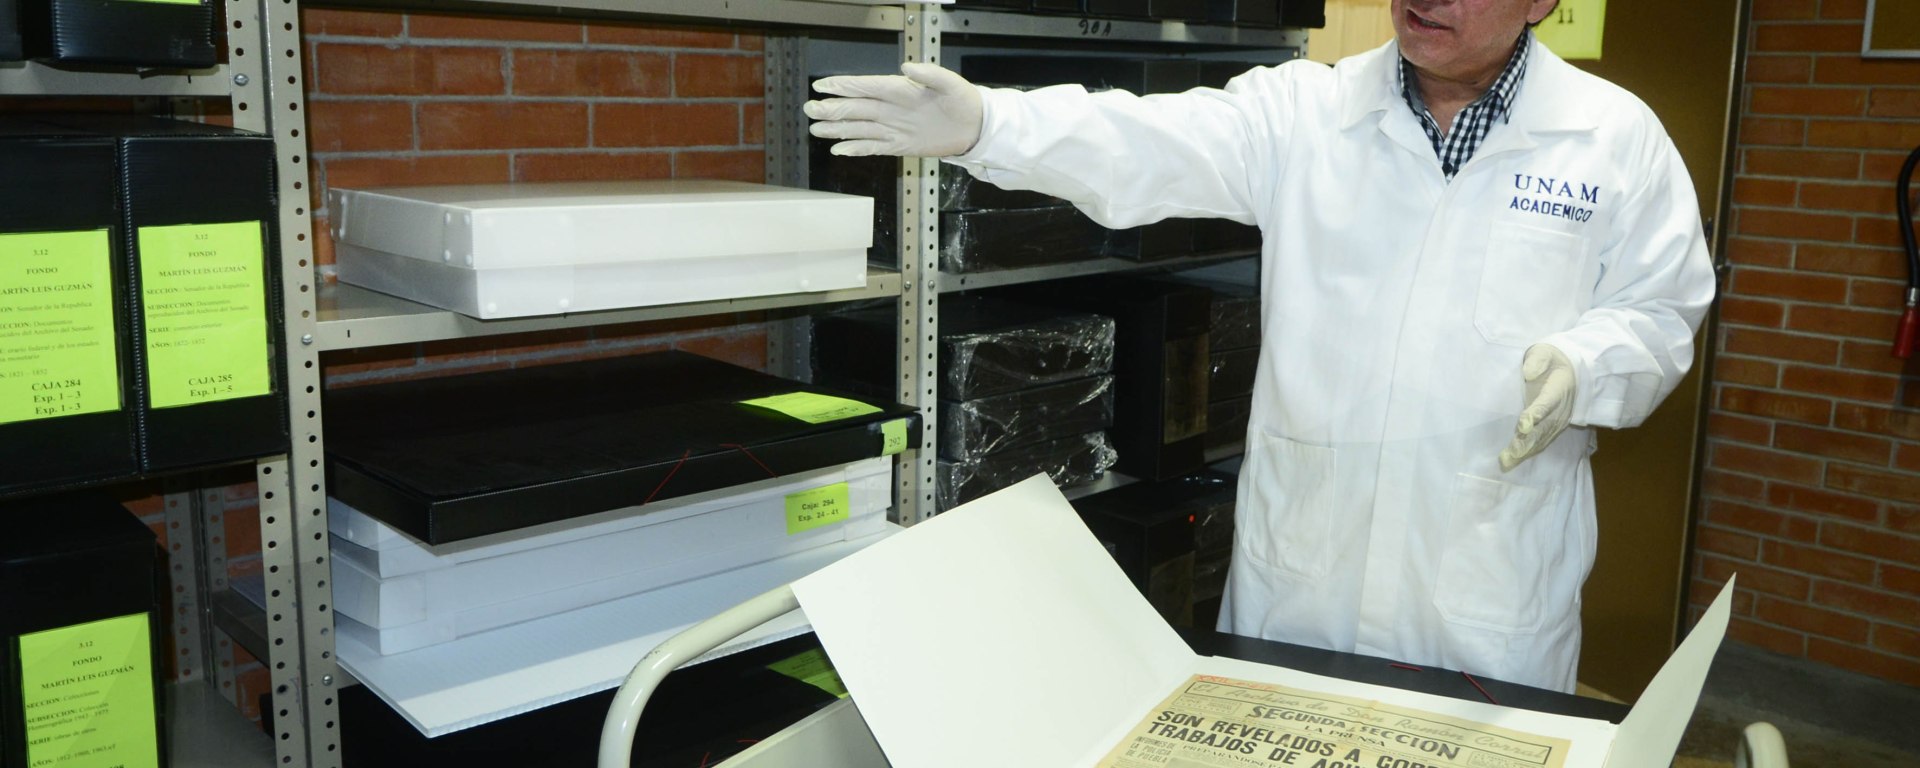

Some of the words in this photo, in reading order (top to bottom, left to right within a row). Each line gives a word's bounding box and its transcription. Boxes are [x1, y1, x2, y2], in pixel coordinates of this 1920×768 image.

[1558, 8, 1574, 24] 11
[1514, 174, 1600, 204] UNAM
[1509, 196, 1593, 223] ACADEMICO
[26, 267, 58, 275] FONDO
[193, 267, 211, 275] LUIS
[31, 286, 52, 294] LUIS
[31, 381, 62, 391] CAJA
[64, 379, 81, 388] 284
[188, 377, 215, 386] CAJA
[218, 374, 233, 383] 285
[33, 394, 56, 403] Exp.
[75, 390, 81, 399] 3
[190, 388, 210, 398] Exp.
[227, 385, 233, 393] 5
[35, 406, 58, 415] Exp.
[76, 402, 81, 410] 3
[78, 640, 94, 649] 3.12
[72, 655, 103, 667] FONDO
[41, 677, 75, 690] MARTÍN
[77, 672, 97, 683] LUIS
[98, 664, 135, 678] GUZMÁN
[1157, 710, 1205, 728] SON
[1210, 720, 1337, 757] REVELADOS
[1344, 748, 1362, 763] A
[1245, 706, 1346, 728] SEGUNDA
[1360, 726, 1461, 761] SECCION
[1305, 725, 1323, 734] LA
[1329, 730, 1385, 747] PRENSA
[1147, 721, 1258, 754] TRABAJOS
[1268, 747, 1301, 765] DE
[1475, 736, 1548, 758] Corral
